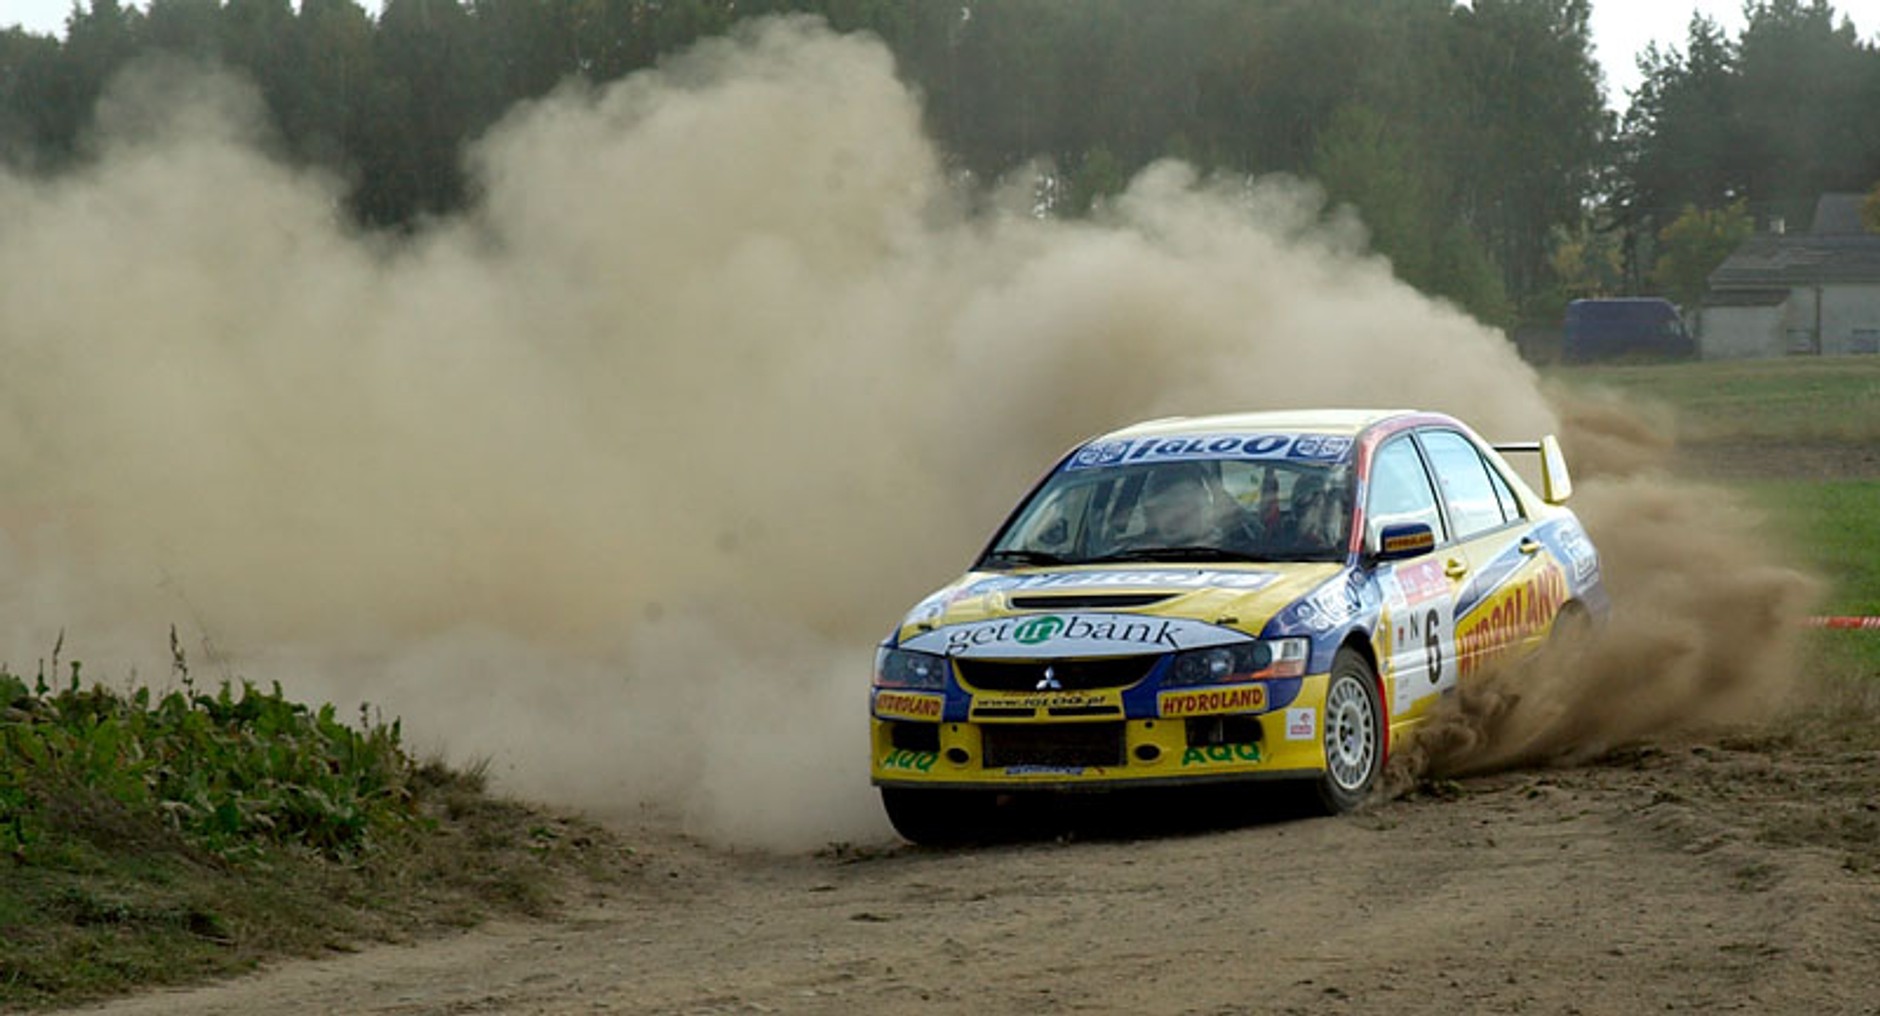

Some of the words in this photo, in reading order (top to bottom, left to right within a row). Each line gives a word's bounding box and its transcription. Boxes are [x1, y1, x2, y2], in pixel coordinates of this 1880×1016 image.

[1410, 611, 1419, 639] N
[1426, 609, 1442, 684] 6
[1163, 687, 1263, 714] HYDROLAND
[881, 749, 939, 773] AQQ
[1182, 740, 1262, 766] AQQ
